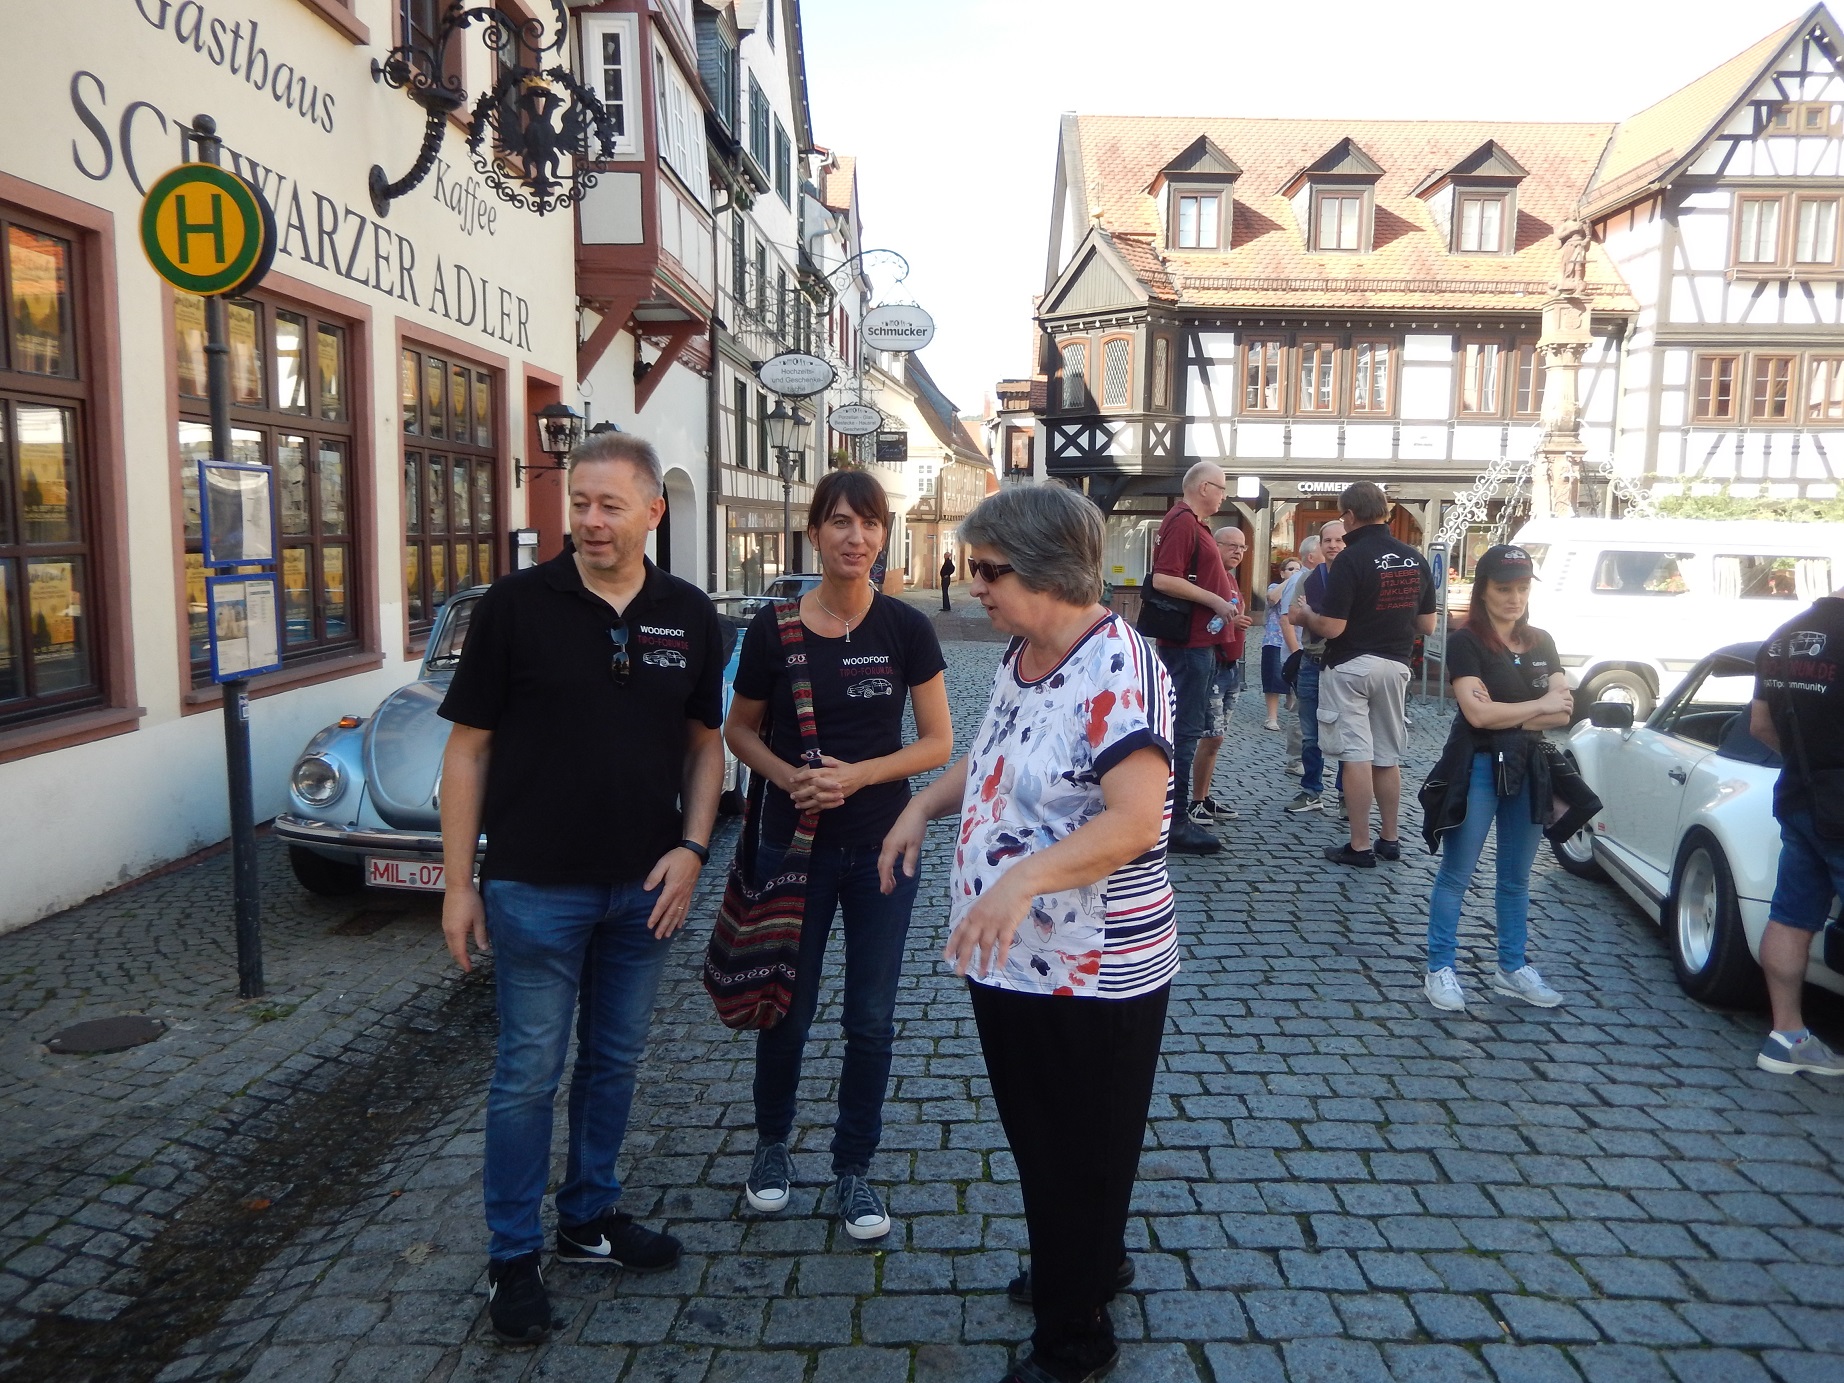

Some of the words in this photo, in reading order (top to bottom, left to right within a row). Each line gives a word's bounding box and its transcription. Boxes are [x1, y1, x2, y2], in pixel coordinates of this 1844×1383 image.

[433, 155, 497, 237] Kaffee
[175, 194, 226, 264] H
[428, 254, 532, 352] ADLER
[867, 326, 928, 337] Schmucker
[640, 625, 685, 637] WOODFOOT
[842, 655, 890, 666] WOODFOOT
